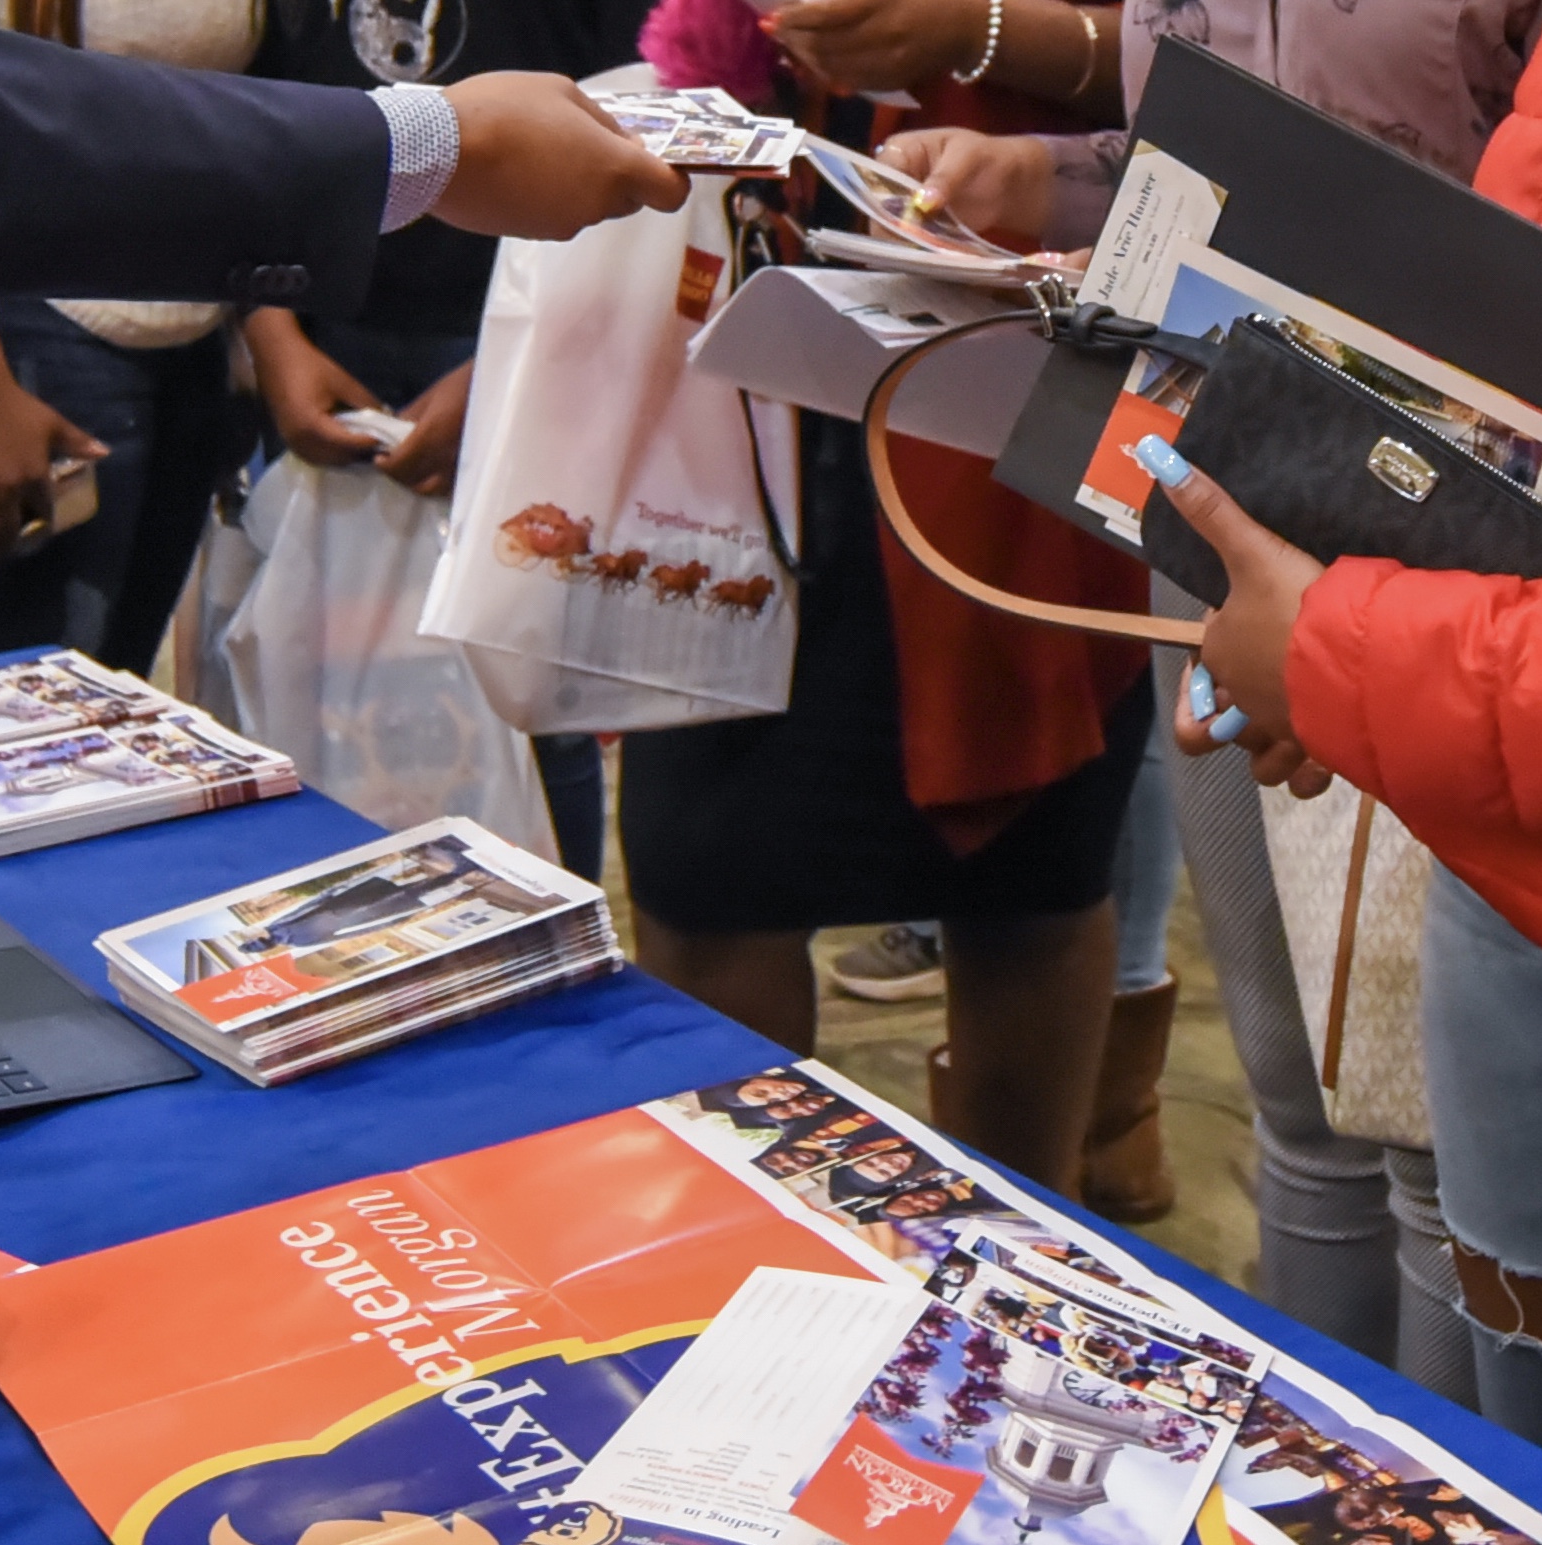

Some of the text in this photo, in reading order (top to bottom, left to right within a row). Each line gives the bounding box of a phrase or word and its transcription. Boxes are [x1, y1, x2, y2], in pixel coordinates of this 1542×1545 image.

[1095, 266, 1120, 299] Jade
[1124, 172, 1157, 228] Hunter
[346, 1187, 542, 1338] Morgan
[683, 1506, 702, 1521] in
[842, 1450, 956, 1515] MORGAN
[704, 1507, 783, 1539] Leading
